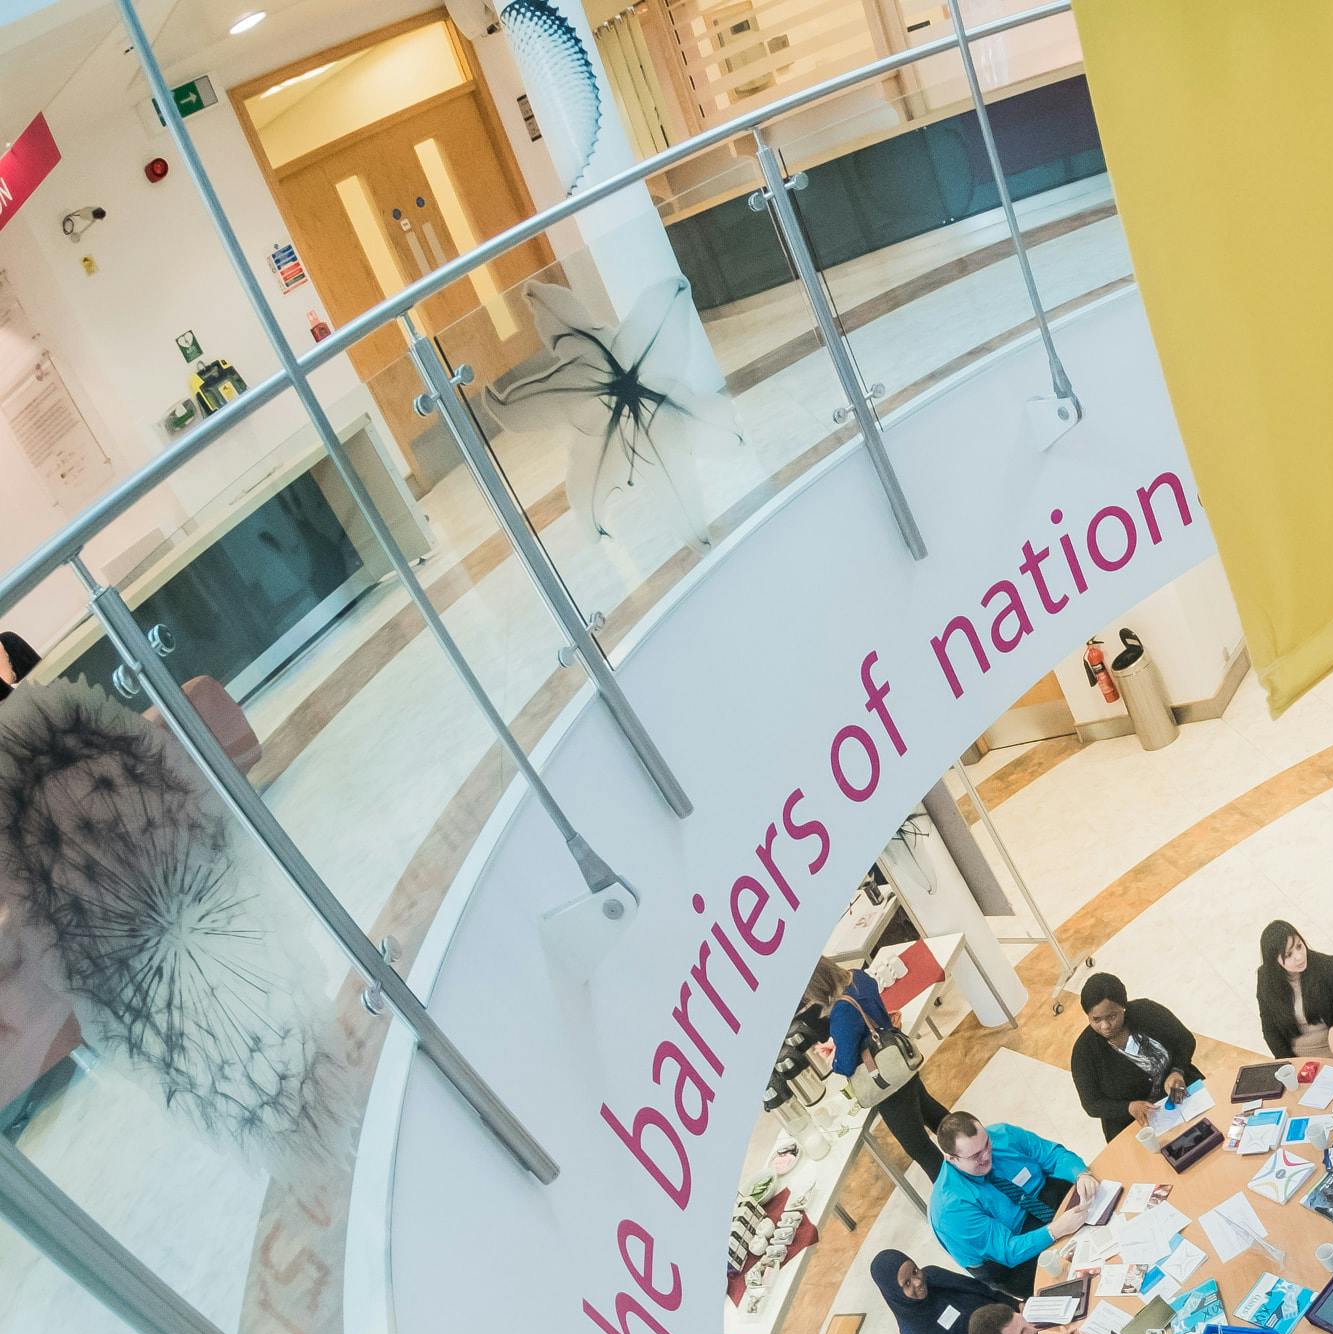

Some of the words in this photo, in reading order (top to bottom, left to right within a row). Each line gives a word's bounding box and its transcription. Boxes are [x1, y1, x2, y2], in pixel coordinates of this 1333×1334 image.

[600, 788, 831, 1210] barriers
[831, 651, 908, 803] of
[930, 471, 1203, 699] nation
